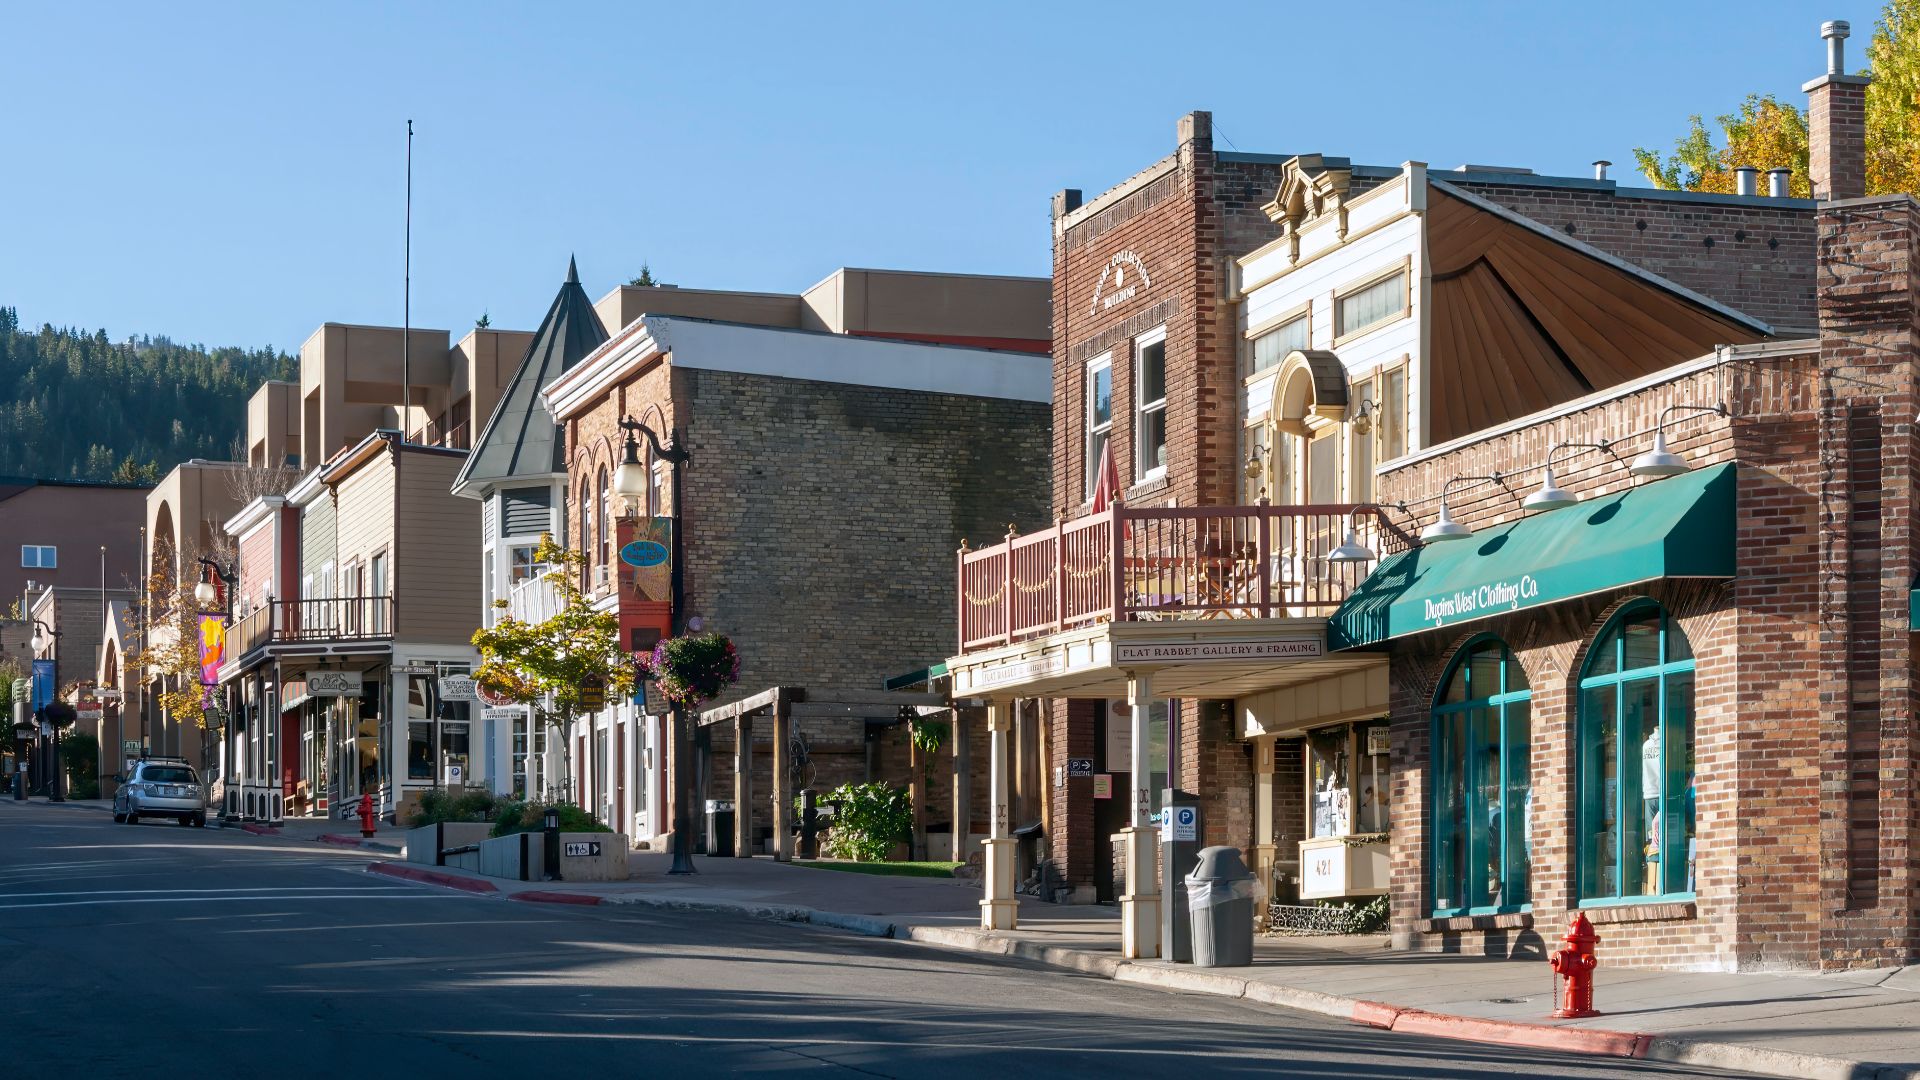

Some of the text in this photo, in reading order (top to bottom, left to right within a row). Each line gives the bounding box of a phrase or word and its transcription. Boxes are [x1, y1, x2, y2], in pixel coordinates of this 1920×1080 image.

[1111, 250, 1150, 290] COLLECTION
[1104, 286, 1136, 309] BUILDING
[1425, 575, 1539, 626] Dugins West Clothing Co.
[1123, 644, 1316, 657] FLAT RABBET GALLERY & FRAMING
[126, 741, 141, 749] ATM
[1315, 859, 1331, 876] 421
